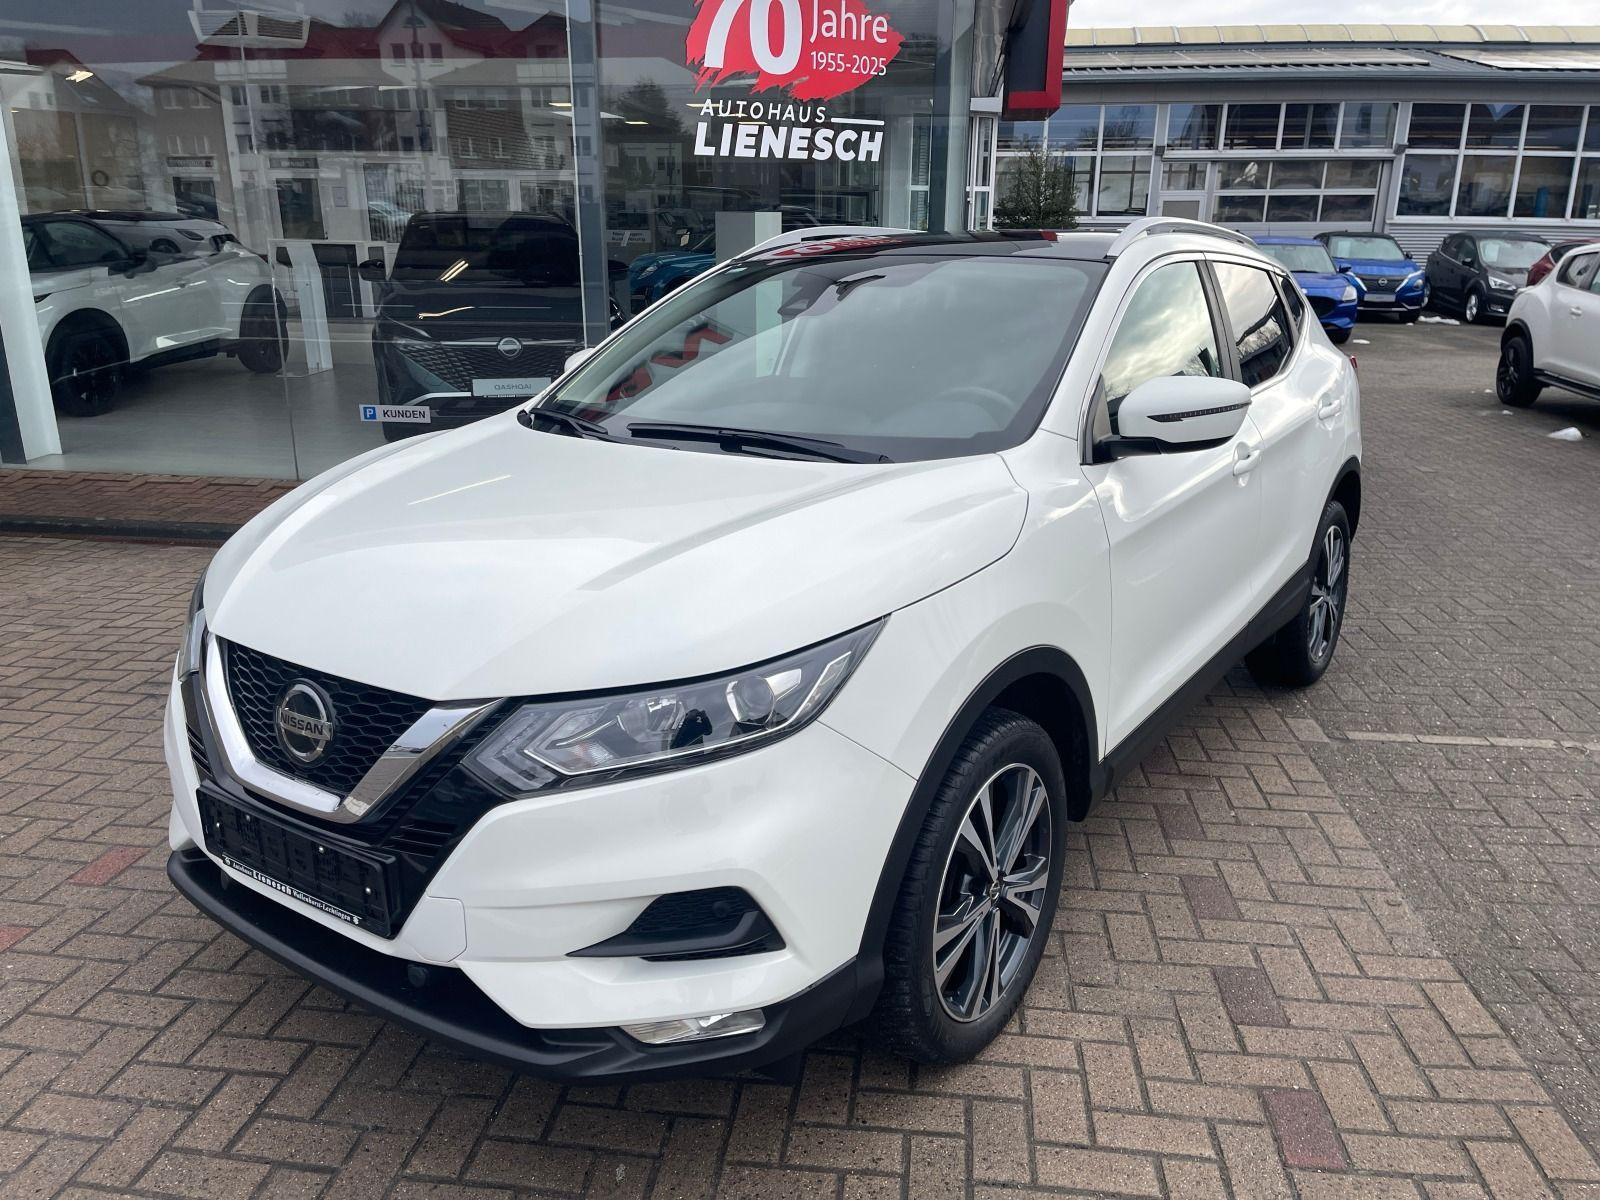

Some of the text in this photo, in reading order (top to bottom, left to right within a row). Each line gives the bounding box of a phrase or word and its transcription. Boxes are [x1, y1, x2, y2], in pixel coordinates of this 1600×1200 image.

[810, 0, 888, 44] Jahre
[704, 0, 803, 75] 70
[811, 51, 887, 76] 1955-2025
[700, 98, 826, 123] AUTOHAUS
[694, 122, 884, 162] LIENESCH
[383, 409, 426, 419] KUNDEN
[281, 711, 324, 736] NISSAN
